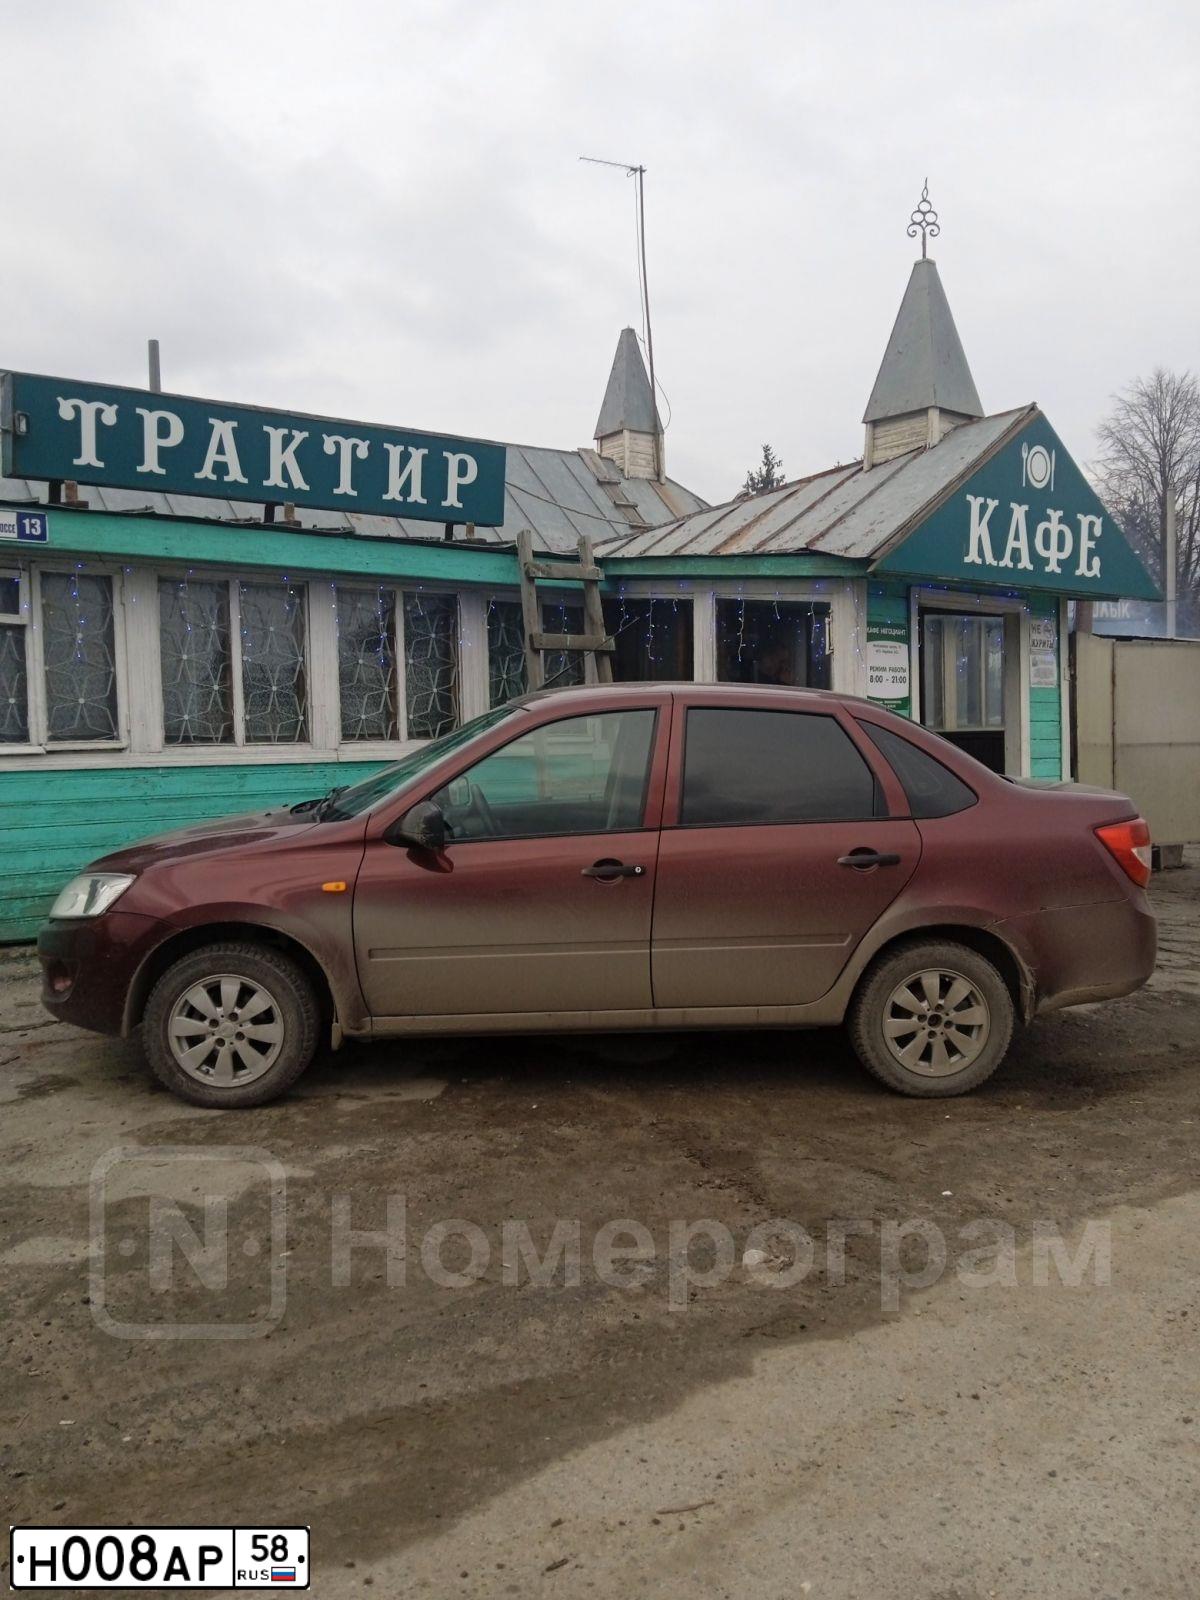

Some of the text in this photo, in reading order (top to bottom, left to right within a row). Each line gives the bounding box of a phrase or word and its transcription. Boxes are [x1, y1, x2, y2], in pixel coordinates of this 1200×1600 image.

[57, 396, 478, 509] ТРАКТИР
[22, 518, 41, 536] 13
[963, 494, 1103, 578] КАФЕ
